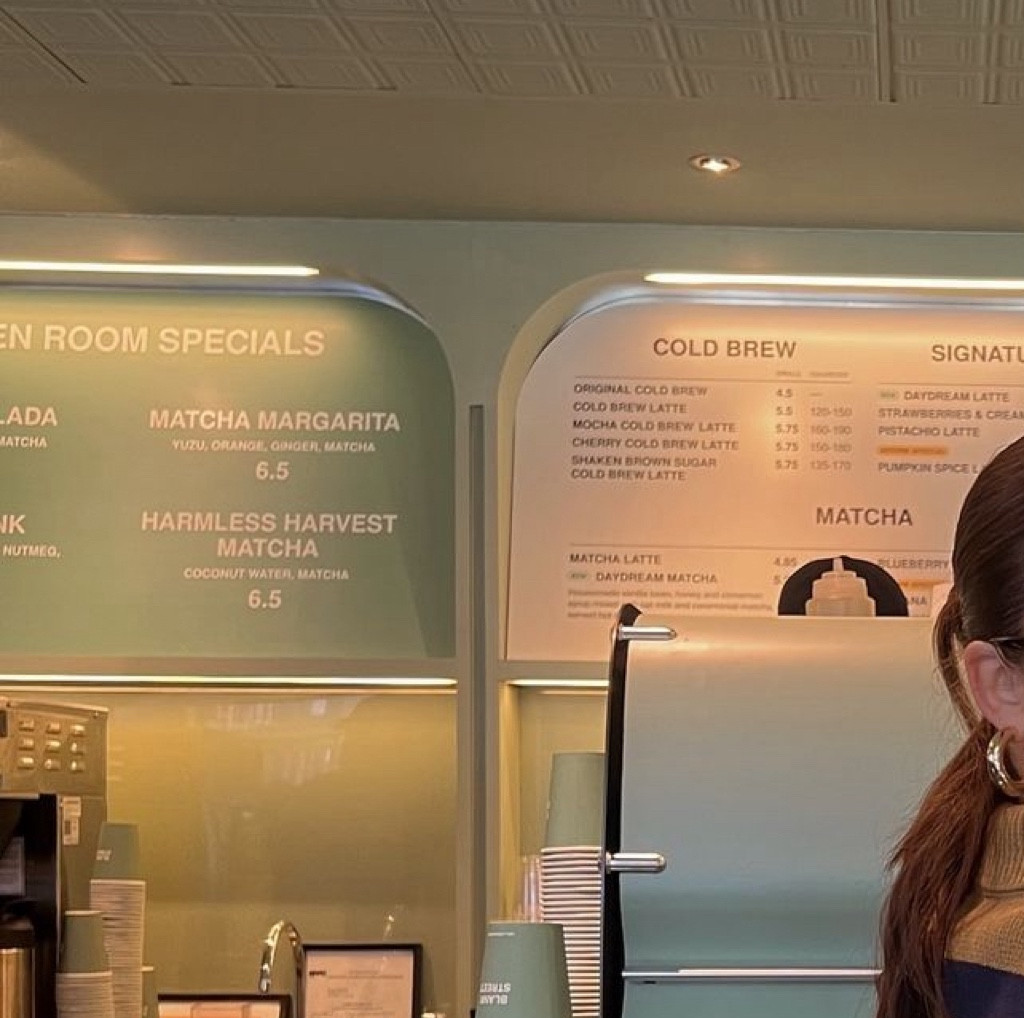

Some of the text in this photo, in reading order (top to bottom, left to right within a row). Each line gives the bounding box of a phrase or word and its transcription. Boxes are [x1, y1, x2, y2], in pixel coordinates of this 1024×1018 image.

[44, 325, 148, 353] ROOM
[158, 328, 325, 357] SPECIALS
[653, 338, 797, 358] COLD BREW
[573, 383, 708, 396] ORIGINAL COLD BREW
[775, 388, 793, 398] 4.5
[904, 391, 970, 401] DAYDREAM
[973, 392, 1009, 402] LATTE
[573, 402, 687, 414] COLD BREW LATTE
[775, 406, 793, 416] 5.5
[878, 407, 972, 419] STRAWBERRIES
[150, 409, 400, 431] MATCHA MARGARITA
[573, 419, 736, 433] MOCHA COLD BREW LATTE
[878, 426, 980, 437] PISTACHIO LATTE
[171, 439, 209, 452] YUZU,
[324, 441, 376, 452] MATCHA
[572, 437, 739, 450] CHERRY COLD BREW LATTE
[571, 455, 717, 468] SHAKEN BROWN SUGAR
[878, 462, 931, 473] PUMPKIN
[934, 463, 969, 474] SPICE
[255, 460, 290, 480] 6.5
[571, 468, 686, 481] COLD BREW LATTE
[141, 511, 398, 534] HARMLESS HARVEST
[816, 506, 913, 526] MATCHA
[217, 538, 319, 558] MATCHA
[570, 554, 662, 565] MATCHA LATTE
[183, 567, 246, 580] COCONUT
[297, 569, 349, 580] MATCHA
[596, 573, 664, 583] DAYDREAM
[667, 573, 717, 584] MATCHA
[248, 588, 282, 609] 6.5
